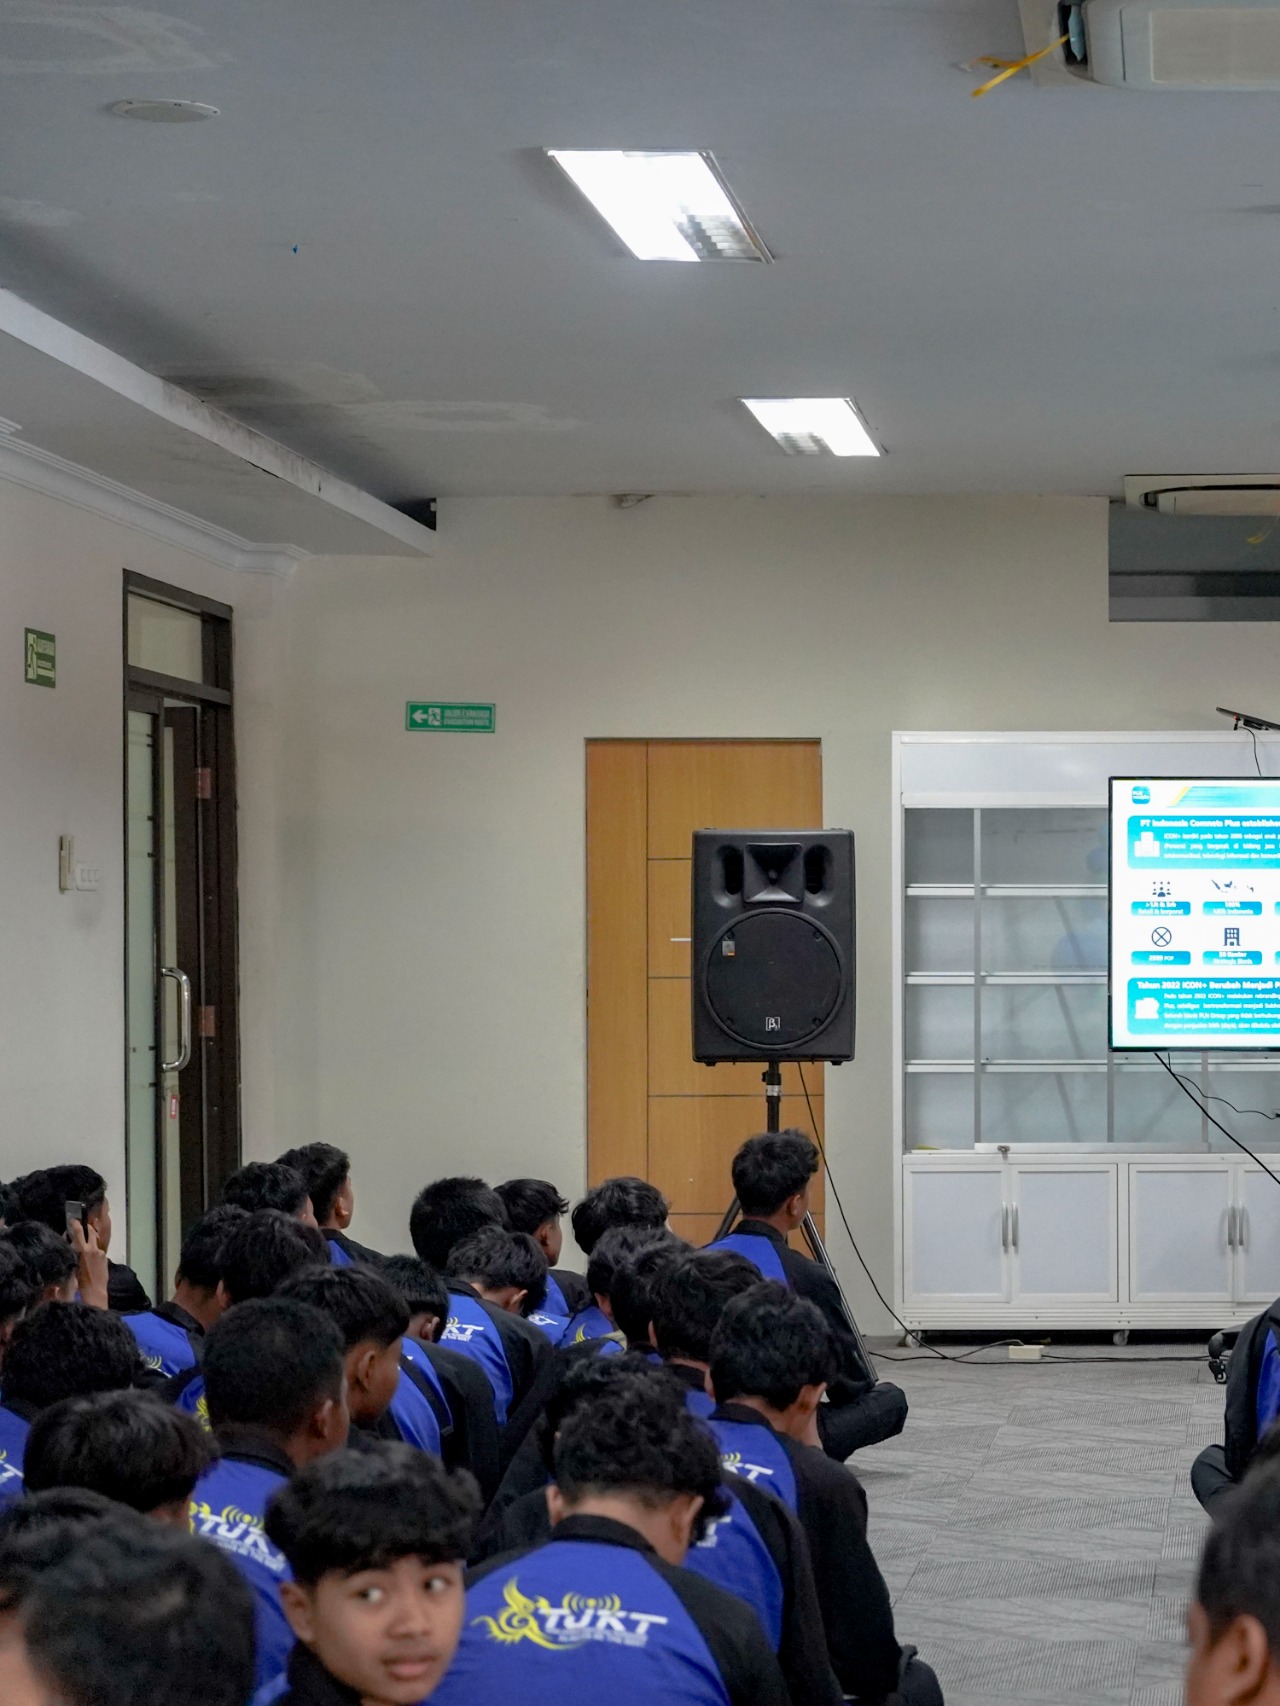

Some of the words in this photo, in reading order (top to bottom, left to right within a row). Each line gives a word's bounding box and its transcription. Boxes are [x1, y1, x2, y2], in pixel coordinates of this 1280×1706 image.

[1243, 982, 1273, 990] Menjadi
[442, 1324, 484, 1335] KT
[722, 1462, 774, 1481] KT
[198, 1512, 269, 1554] TJK
